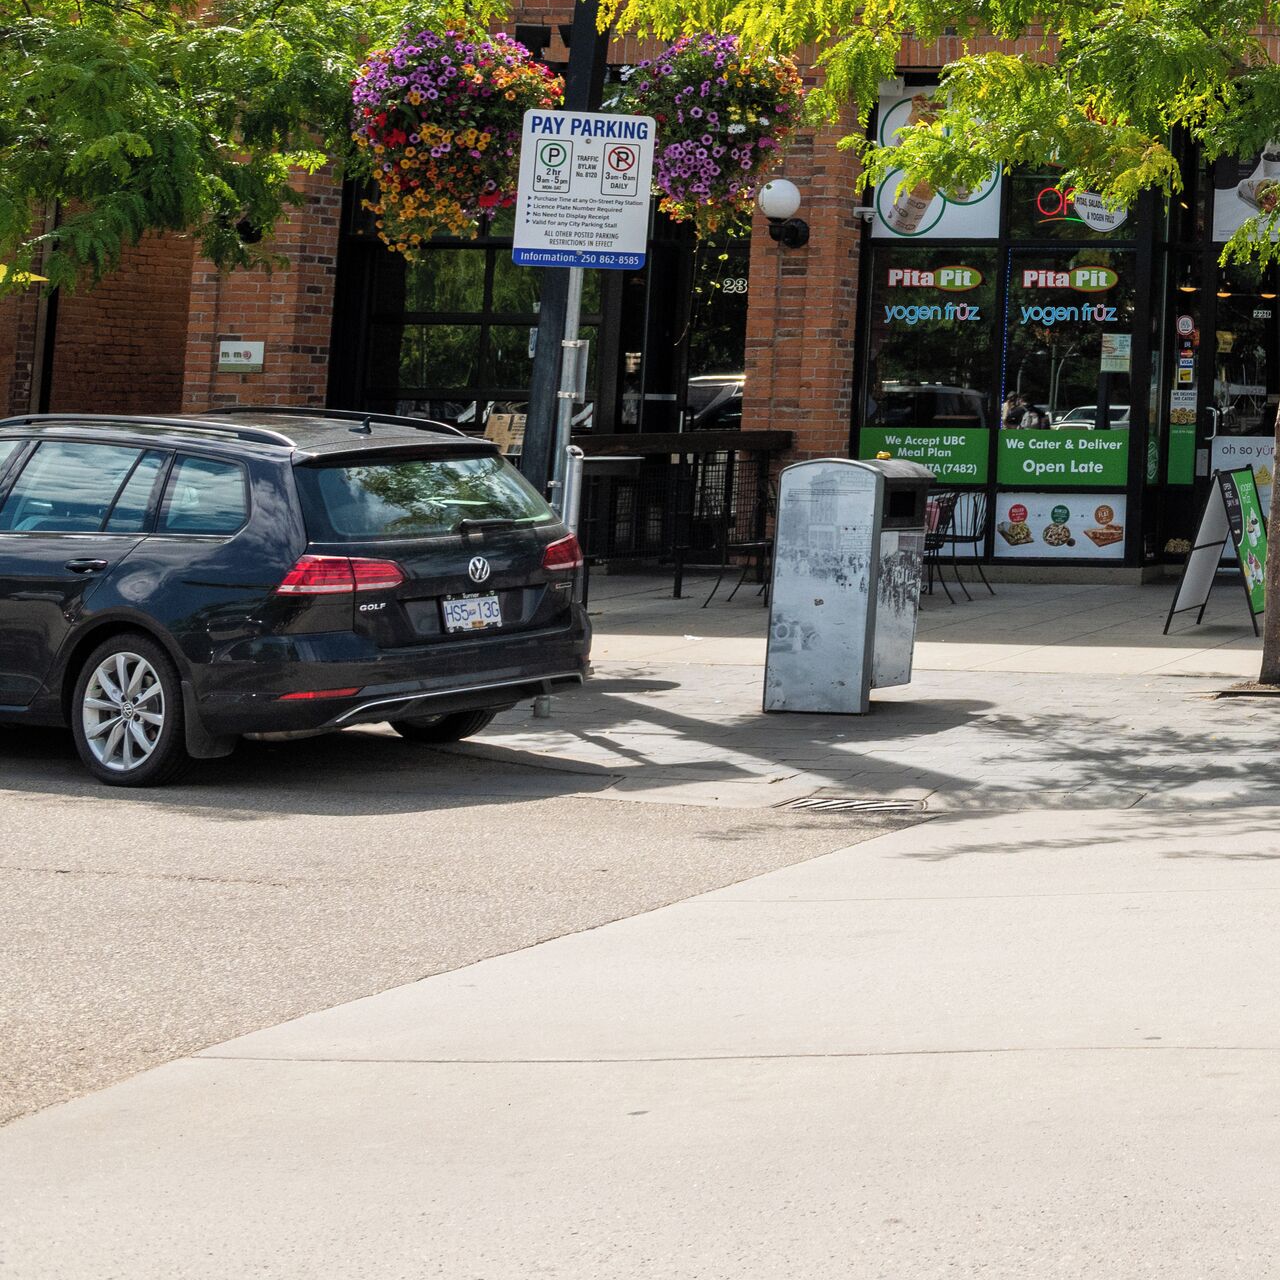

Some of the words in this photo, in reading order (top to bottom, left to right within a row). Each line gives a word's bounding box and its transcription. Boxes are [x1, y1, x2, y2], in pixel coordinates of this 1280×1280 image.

[531, 116, 565, 134] PAY
[570, 118, 648, 140] PARKING
[548, 148, 560, 163] P
[536, 175, 549, 183] 9am
[554, 176, 568, 184] 5pm
[605, 171, 618, 180] 3am
[622, 172, 635, 181] 6am
[549, 238, 586, 246] RESTRICTIONS
[520, 252, 577, 262] Information:
[580, 254, 596, 263] 250
[599, 255, 639, 265] 862-8585
[888, 269, 934, 287] Pita
[940, 269, 972, 286] Pit
[1022, 270, 1070, 287] Pita
[1075, 270, 1108, 287] Pit
[884, 304, 941, 325] yogen
[945, 302, 981, 321] früz
[1021, 305, 1078, 326] yogen
[1081, 302, 1118, 321] früz
[885, 436, 903, 445] We
[905, 436, 940, 447] Accept
[943, 436, 966, 445] UBC
[1006, 439, 1027, 449] We
[1028, 439, 1062, 450] Cater
[1065, 439, 1074, 450] &
[1078, 439, 1122, 450] Deliver
[897, 448, 925, 457] Meal
[927, 448, 952, 457] Plan
[1222, 444, 1236, 455] oh
[1240, 446, 1253, 455] so
[943, 464, 977, 475] (7482)
[1022, 460, 1067, 475] Open
[1070, 460, 1103, 474] Late
[359, 603, 387, 612] GOLF
[445, 604, 470, 622] HS5
[478, 601, 500, 619] 13G
